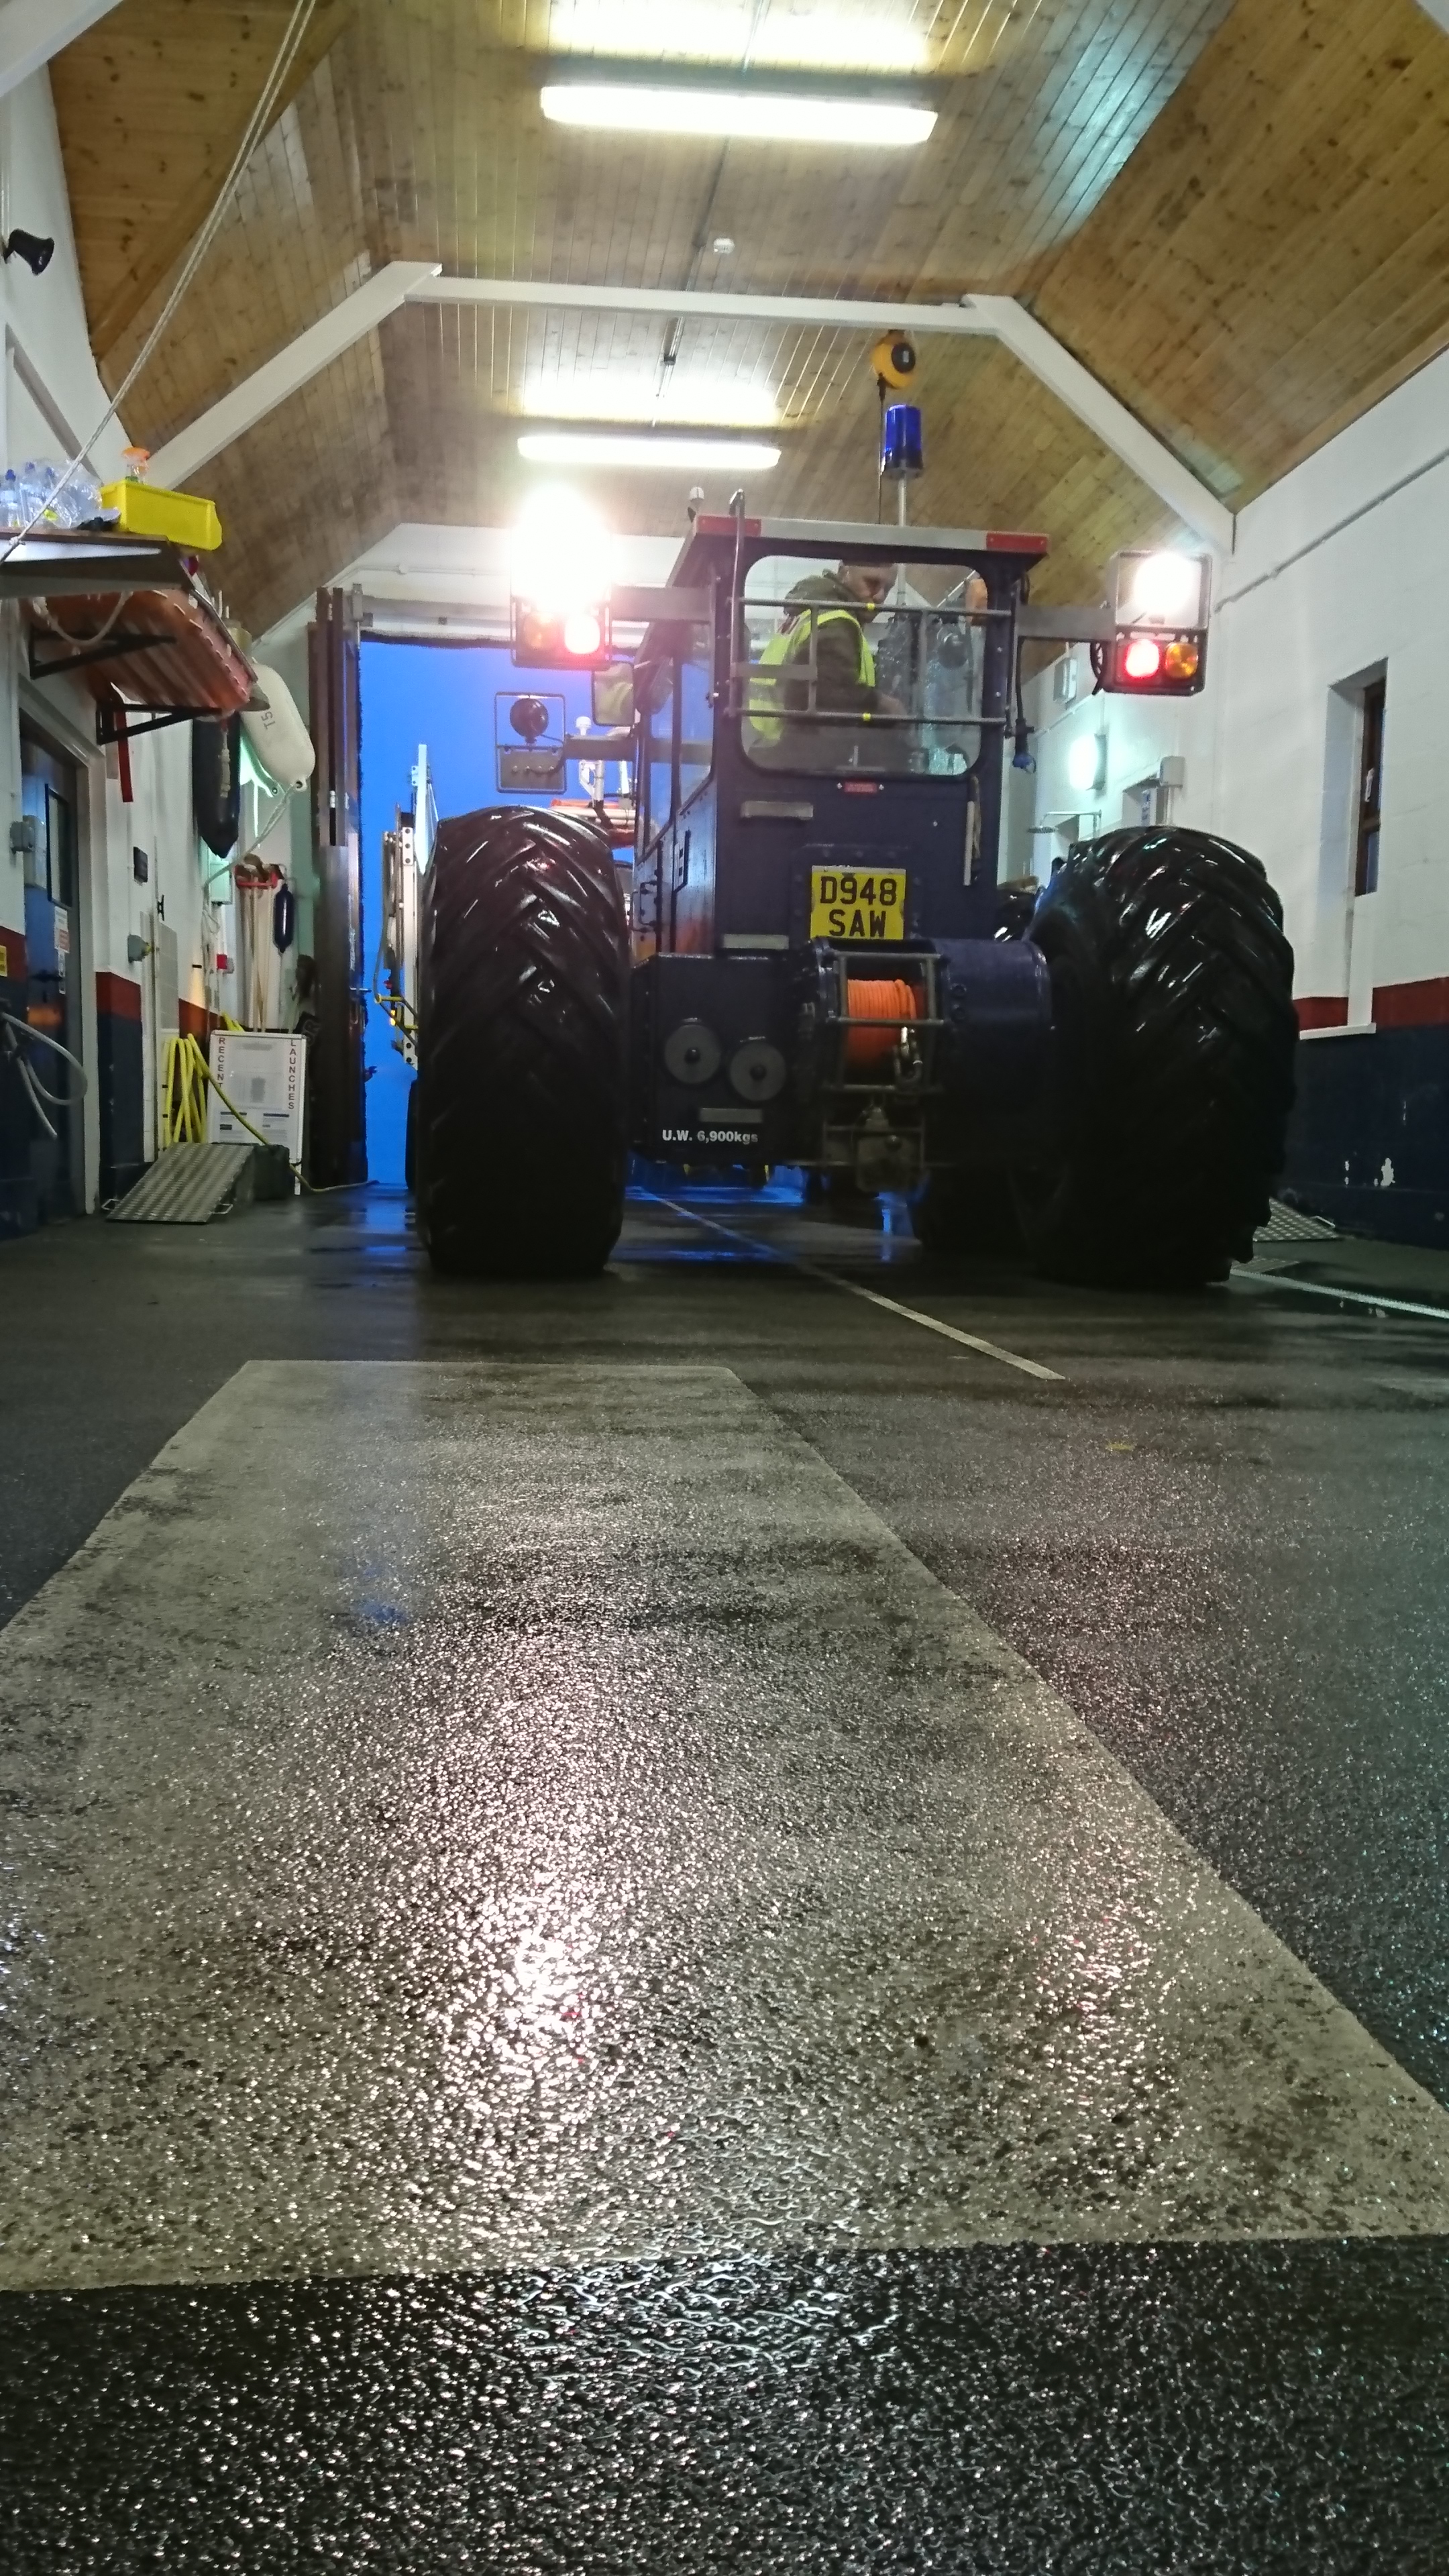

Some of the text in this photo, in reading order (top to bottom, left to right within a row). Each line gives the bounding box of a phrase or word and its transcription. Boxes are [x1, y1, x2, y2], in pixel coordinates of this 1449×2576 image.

[820, 875, 897, 906] D948
[828, 908, 886, 938] SAW
[217, 1037, 225, 1087] RECENT
[288, 1040, 297, 1110] LAUNCHES
[662, 1129, 759, 1145] U.W. 6,900kgs
